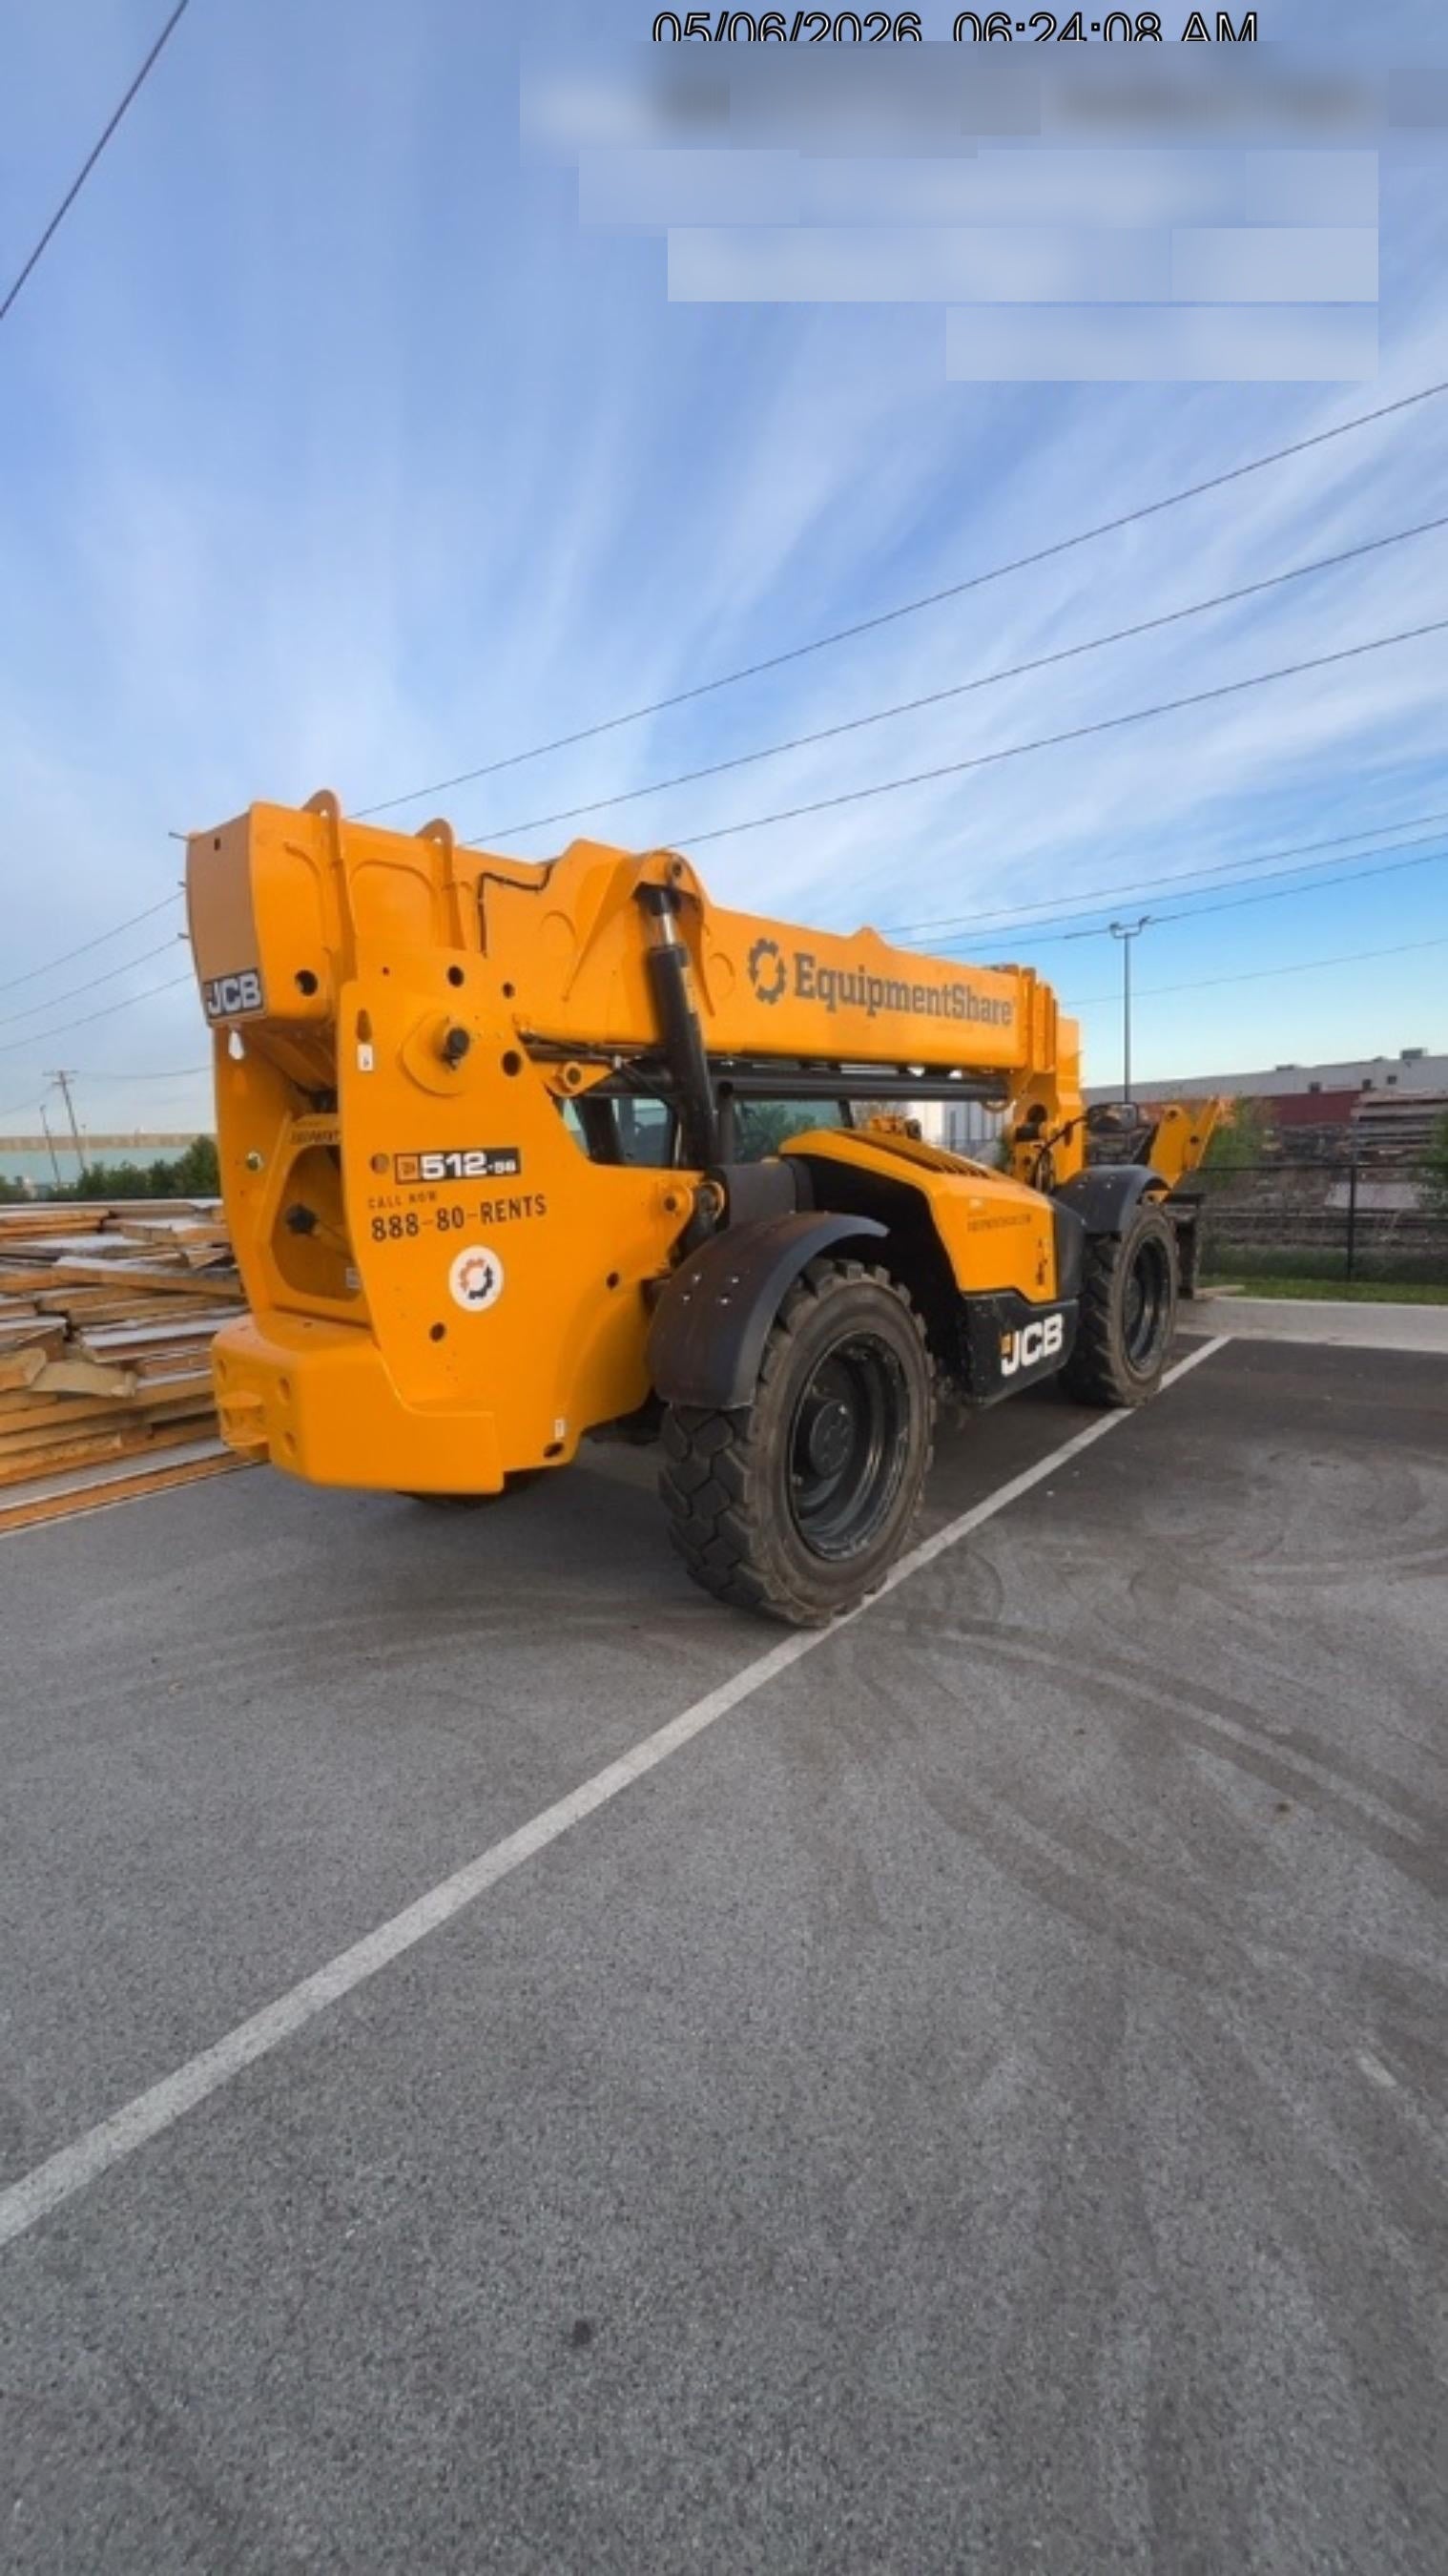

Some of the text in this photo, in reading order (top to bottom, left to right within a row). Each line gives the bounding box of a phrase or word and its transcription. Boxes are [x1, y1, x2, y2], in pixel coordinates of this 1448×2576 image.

[206, 973, 261, 1014] JCB
[793, 952, 1013, 1027] EquipmentShare
[368, 1196, 402, 1209] CALL
[371, 1194, 548, 1242] 888-80-RENTS
[1000, 1313, 1063, 1377] JCB
